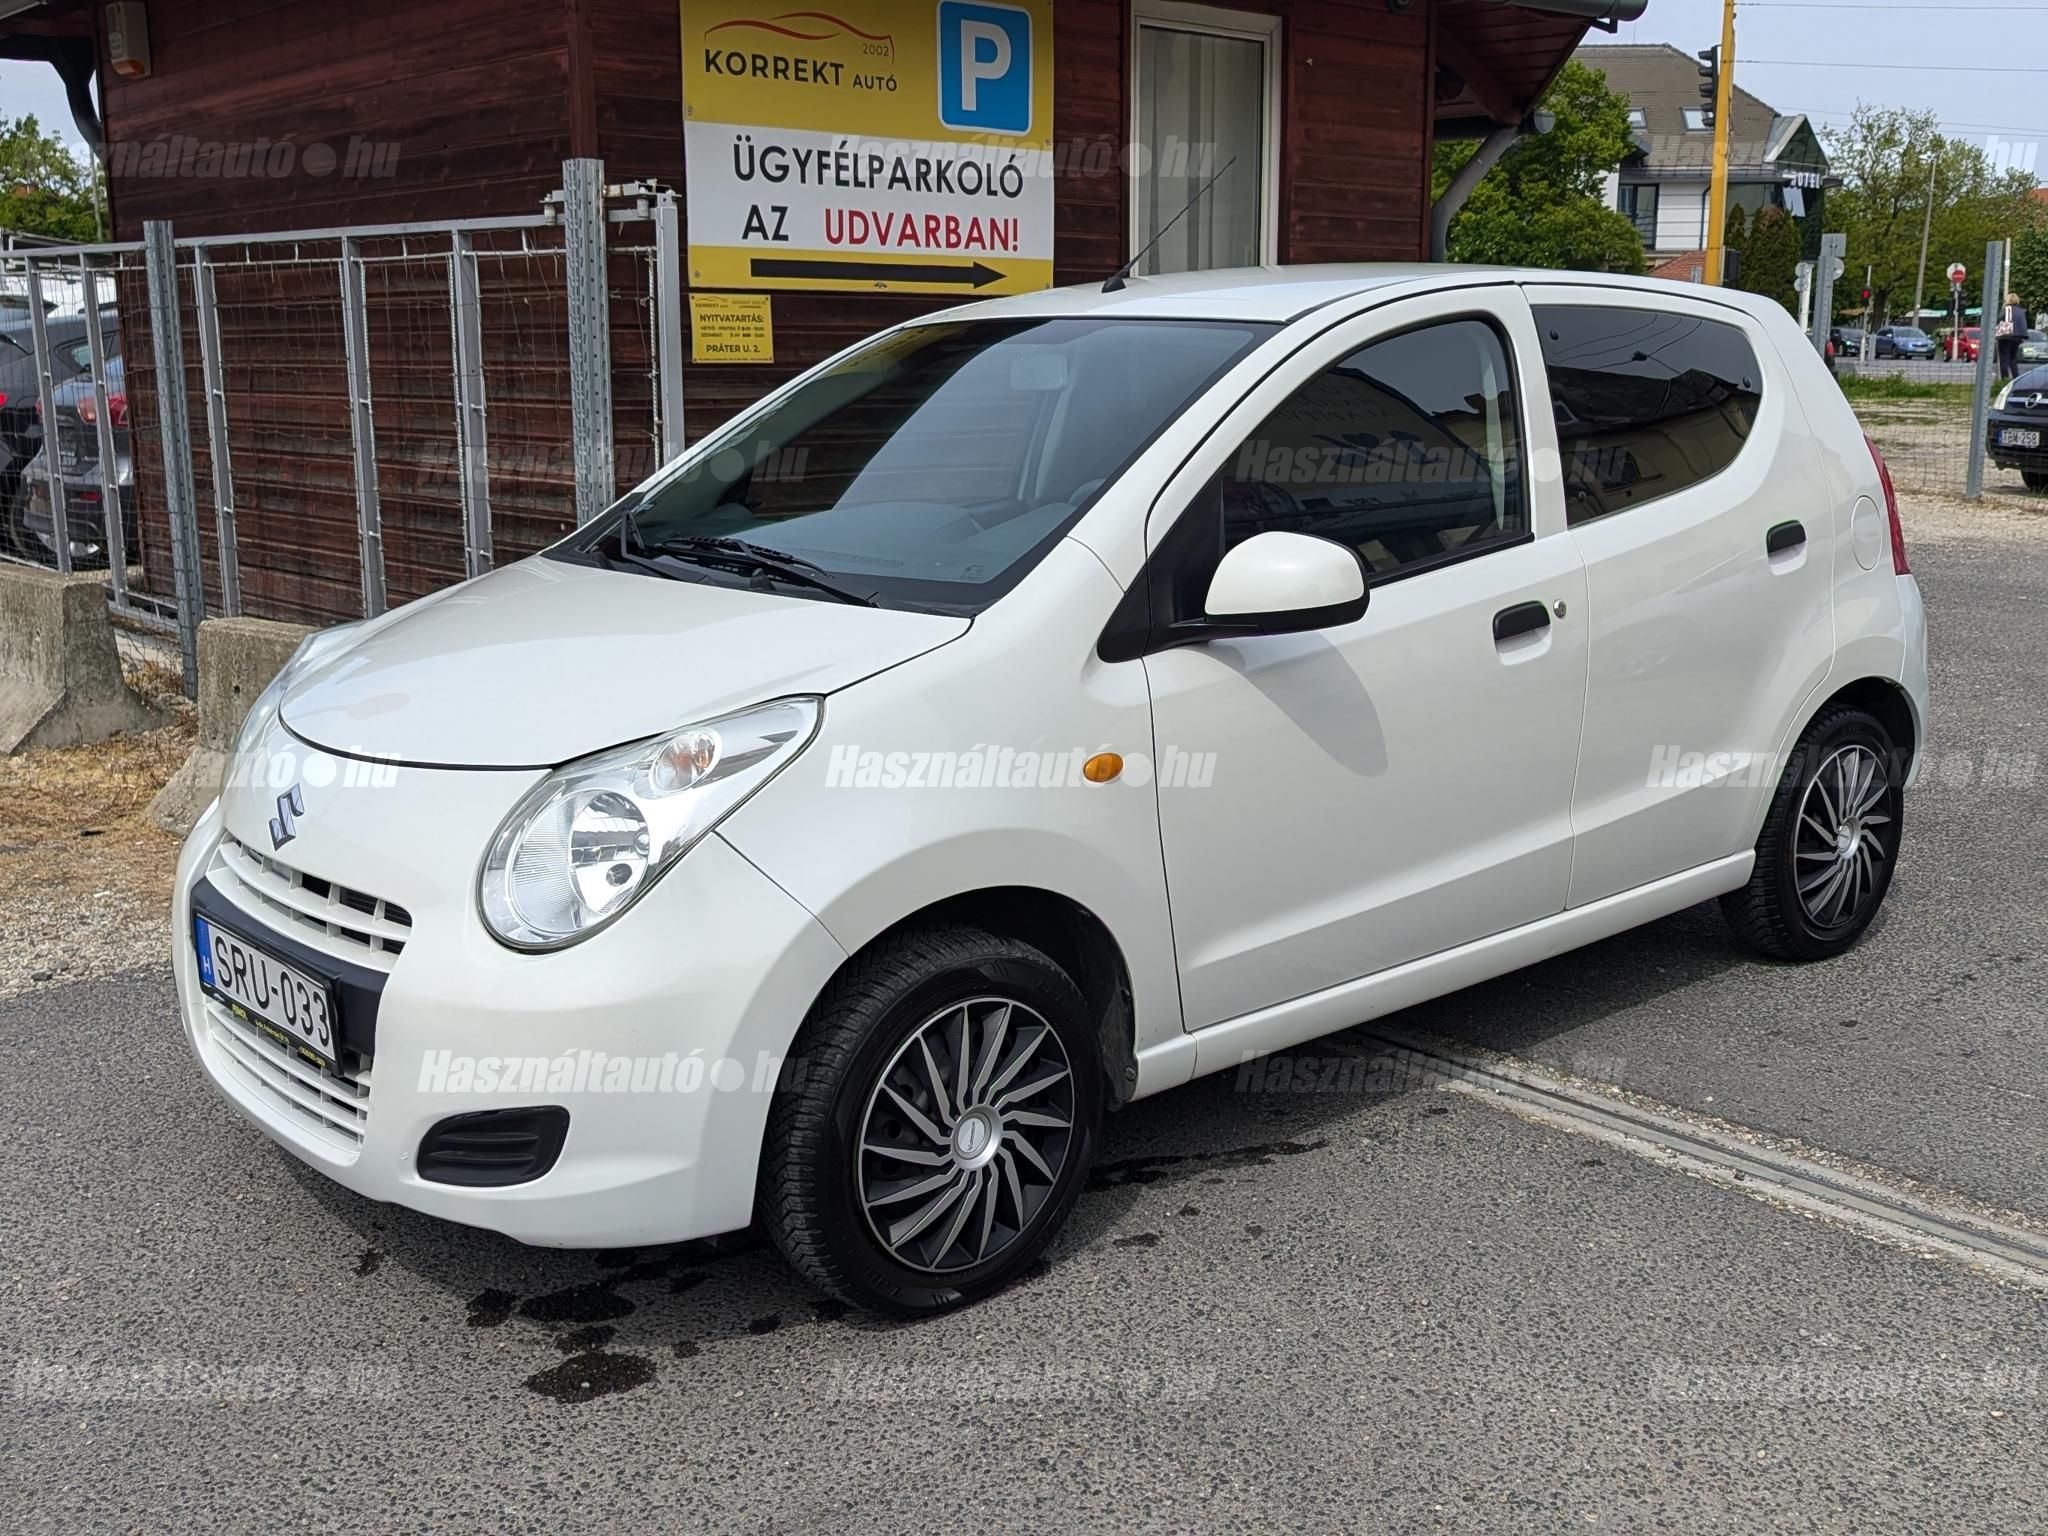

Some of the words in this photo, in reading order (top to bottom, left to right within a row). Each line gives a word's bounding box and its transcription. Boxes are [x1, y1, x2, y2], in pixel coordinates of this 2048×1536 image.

[704, 48, 845, 87] KORREKT
[852, 73, 898, 92] AUTÓ
[862, 43, 890, 57] 2002
[961, 19, 1011, 112] P
[733, 134, 1024, 199] ÜGYFÉLPARKOLÓ
[741, 204, 790, 242] AZ
[824, 208, 1019, 252] UDVARBAN!
[706, 343, 741, 353] PRÁTER
[743, 344, 752, 353] U.
[202, 954, 212, 976] H
[214, 935, 330, 1048] SRU-033
